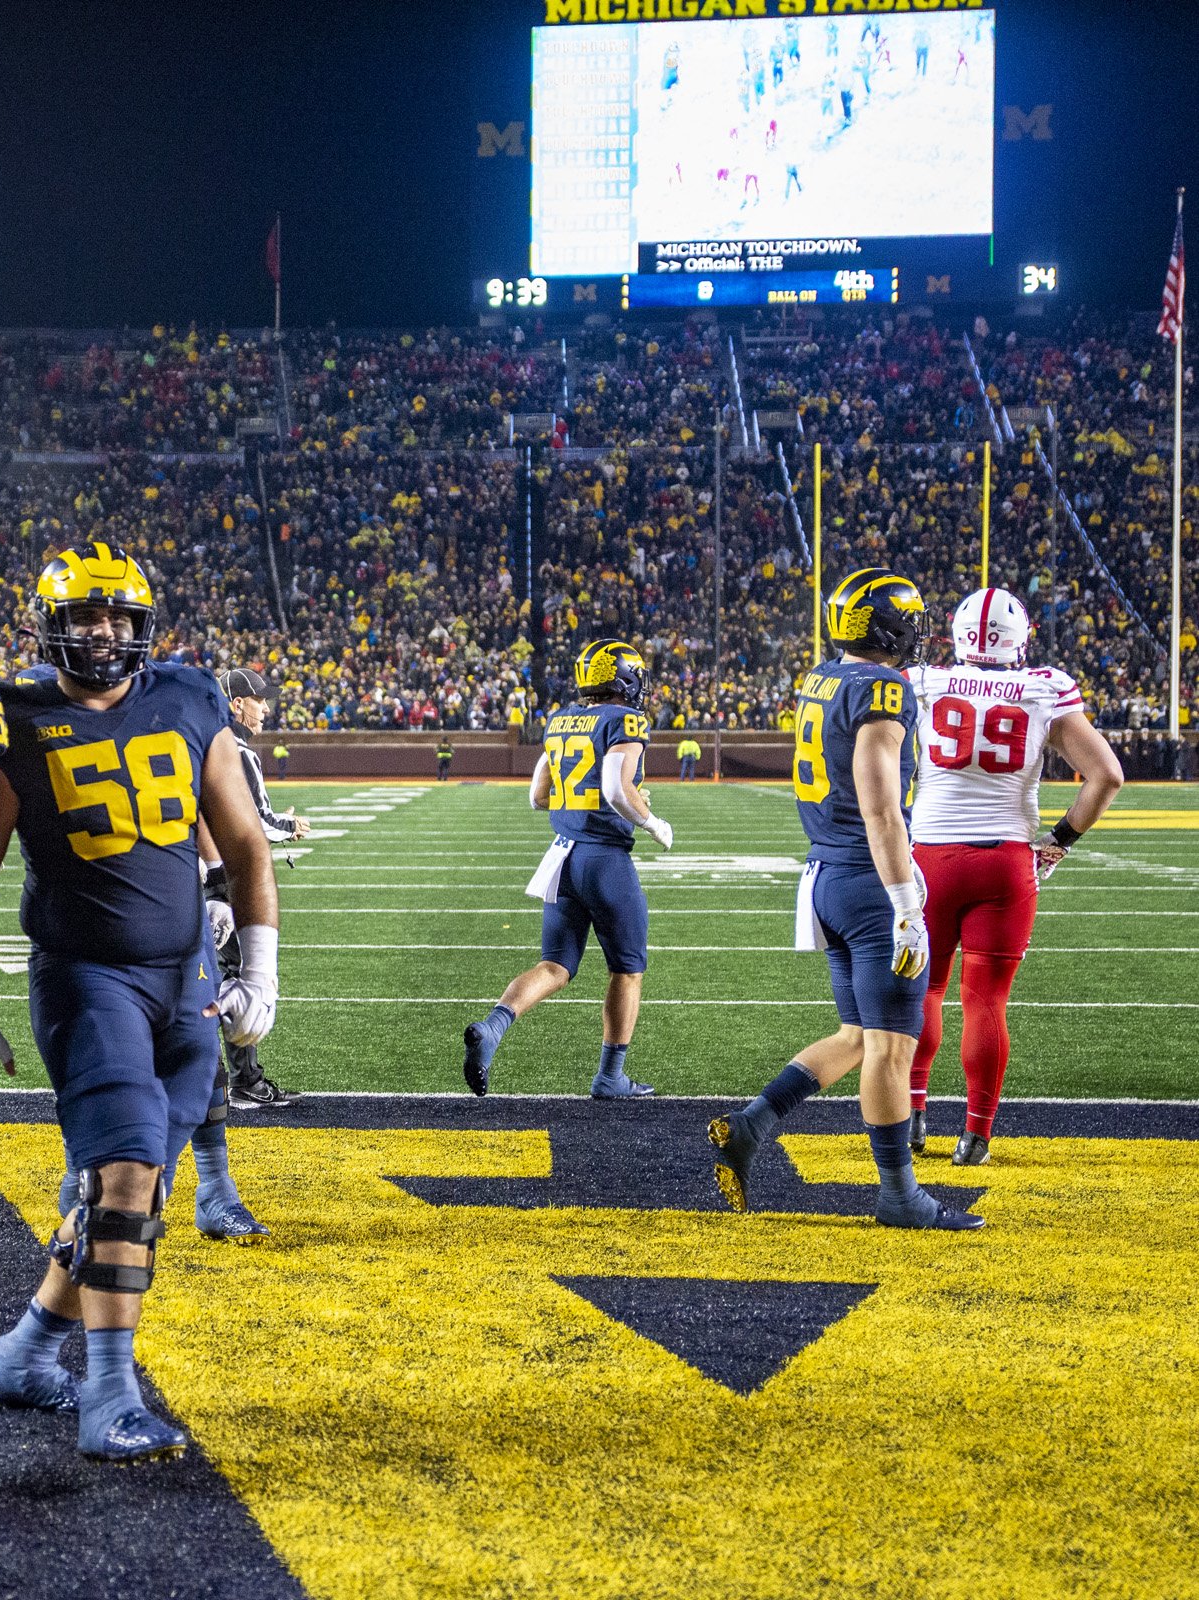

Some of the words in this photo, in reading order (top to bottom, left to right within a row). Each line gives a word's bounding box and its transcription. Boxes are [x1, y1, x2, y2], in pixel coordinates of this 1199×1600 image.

[1003, 104, 1052, 140] M
[477, 121, 525, 157] M
[656, 242, 742, 257] MICHIGAN
[745, 239, 861, 255] TOUCHDOWN.
[749, 256, 783, 271] THE
[834, 270, 874, 290] 4th
[927, 275, 950, 293] M
[1023, 265, 1056, 293] 34
[486, 278, 547, 306] 9:39
[573, 284, 597, 302] M
[842, 289, 867, 302] QTR
[966, 653, 997, 663] HUSKERS
[869, 680, 903, 714] 18
[947, 677, 1025, 701] ROBINSON
[547, 715, 600, 734] BREDESON
[624, 713, 649, 740] 82
[928, 696, 1030, 774] 99
[45, 730, 198, 862] 58
